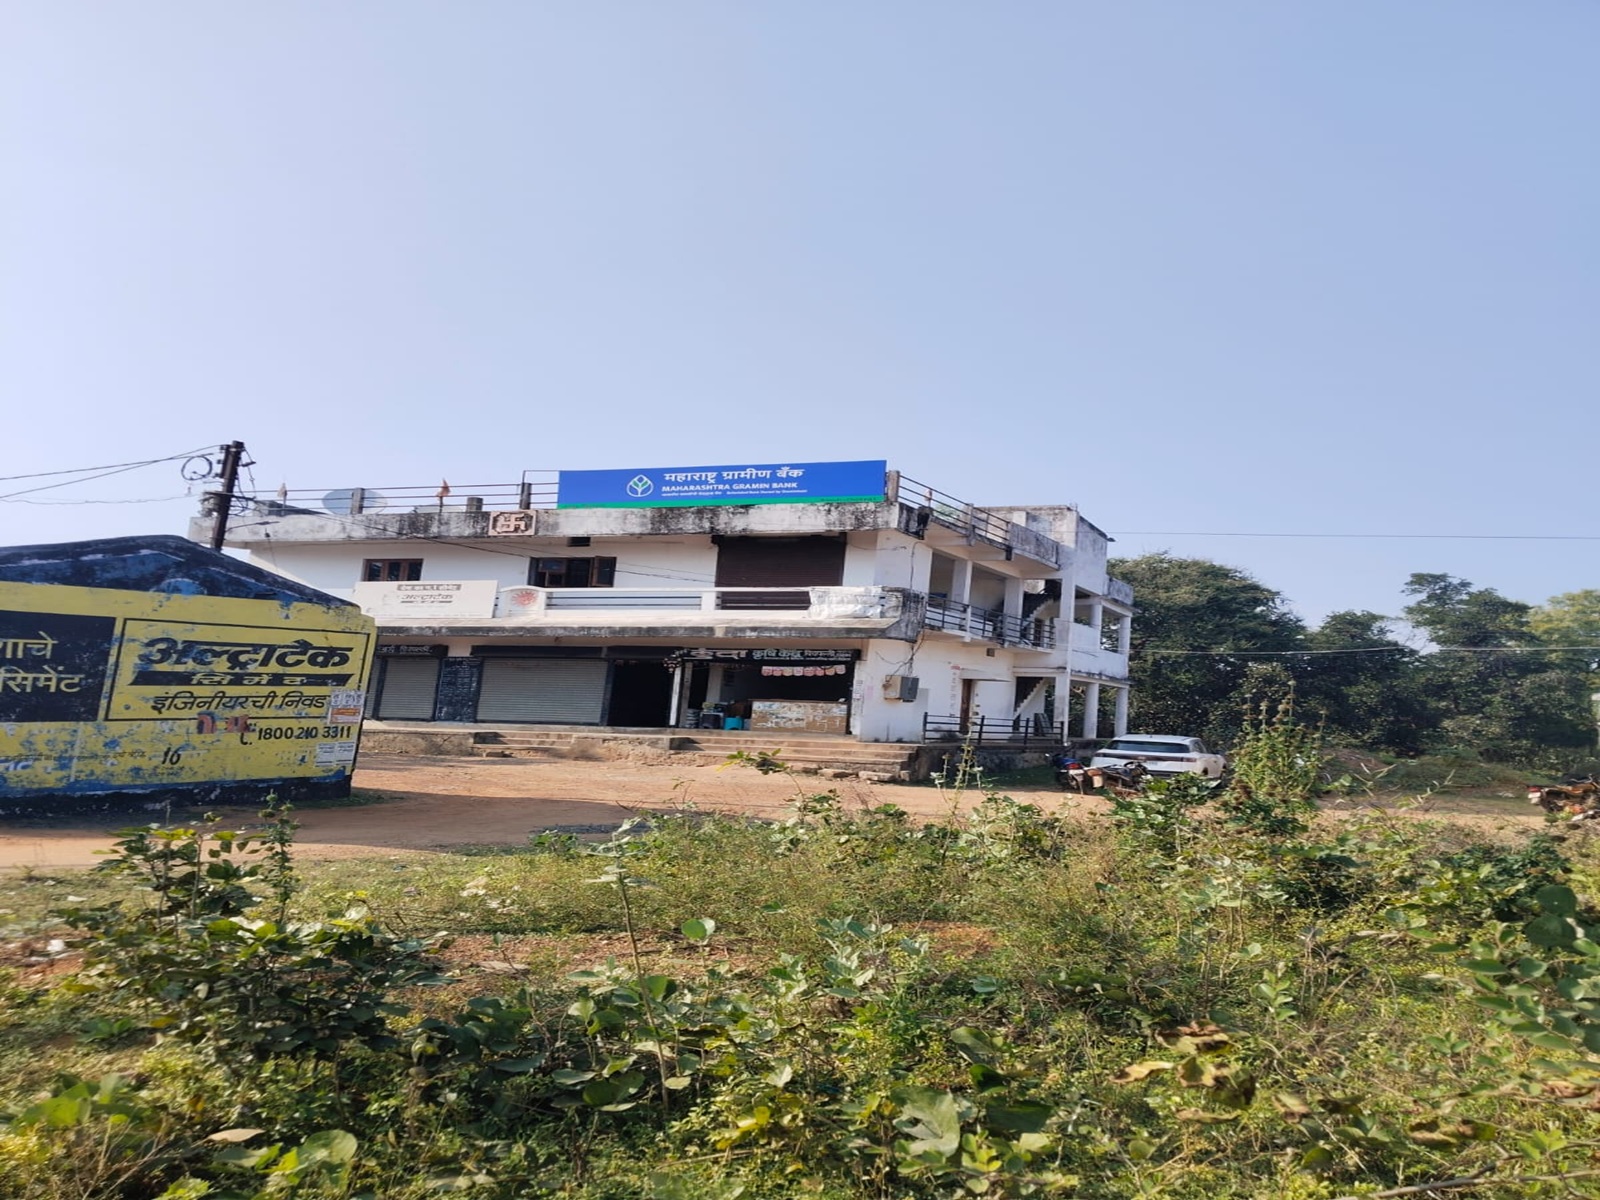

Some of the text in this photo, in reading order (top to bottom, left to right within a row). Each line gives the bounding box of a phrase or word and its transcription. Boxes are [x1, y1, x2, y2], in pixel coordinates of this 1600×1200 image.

[663, 466, 805, 483] महाराष्ट्र ग्रामीण बँक
[661, 483, 730, 492] MAHARASHTRA
[732, 482, 769, 490] GRAMIN
[0, 631, 59, 659] ाचे
[0, 665, 85, 692] सिमेंट
